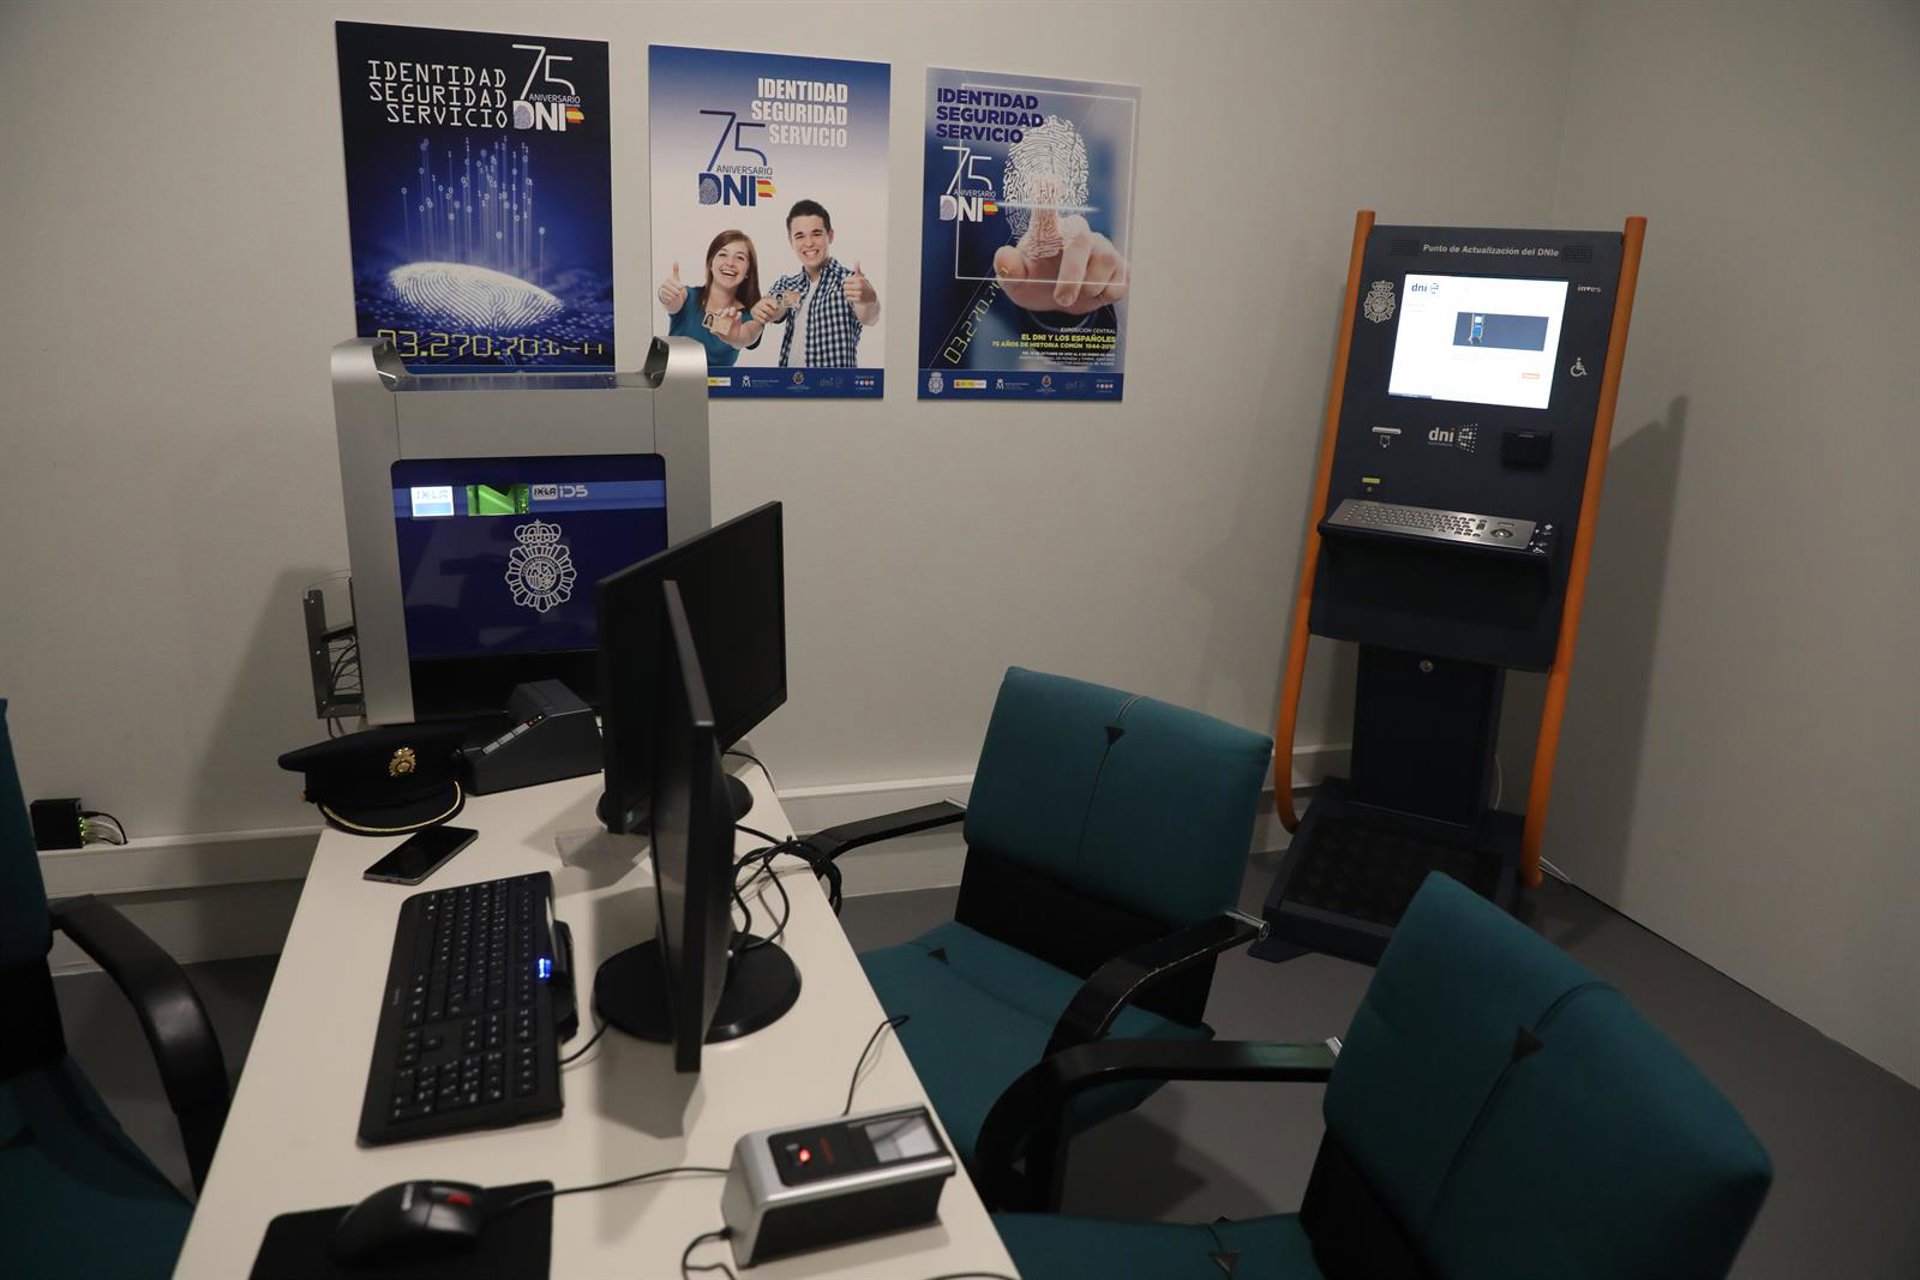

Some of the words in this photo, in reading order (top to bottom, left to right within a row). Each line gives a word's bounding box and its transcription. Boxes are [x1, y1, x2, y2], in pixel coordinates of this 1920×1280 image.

[368, 60, 506, 87] IDENTIDAD
[512, 43, 576, 100] 75
[370, 82, 507, 108] SEGURIDAD
[528, 93, 581, 104] ANIVERSARIO
[758, 77, 849, 104] IDENTIDAD
[936, 88, 1039, 110] IDENTIDAD
[387, 104, 507, 128] SERVICIO
[751, 101, 848, 126] SEGURIDAD
[936, 106, 1044, 128] SEGURIDAD
[699, 109, 768, 172] 75
[769, 124, 847, 148] SERVICIO
[936, 123, 1024, 143] SERVICIO
[716, 165, 774, 176] ANIVERSARIO
[942, 145, 992, 195] 75
[953, 187, 997, 198] ANIVERSARIO
[1422, 244, 1448, 253] Punto
[1449, 245, 1460, 253] de
[1461, 245, 1520, 255] Actualización
[1521, 247, 1536, 256] del
[1537, 248, 1560, 257] DNIe
[1000, 339, 1019, 347] AÑOS
[1071, 333, 1116, 343] ESPAÑOLES
[1428, 427, 1454, 442] dni
